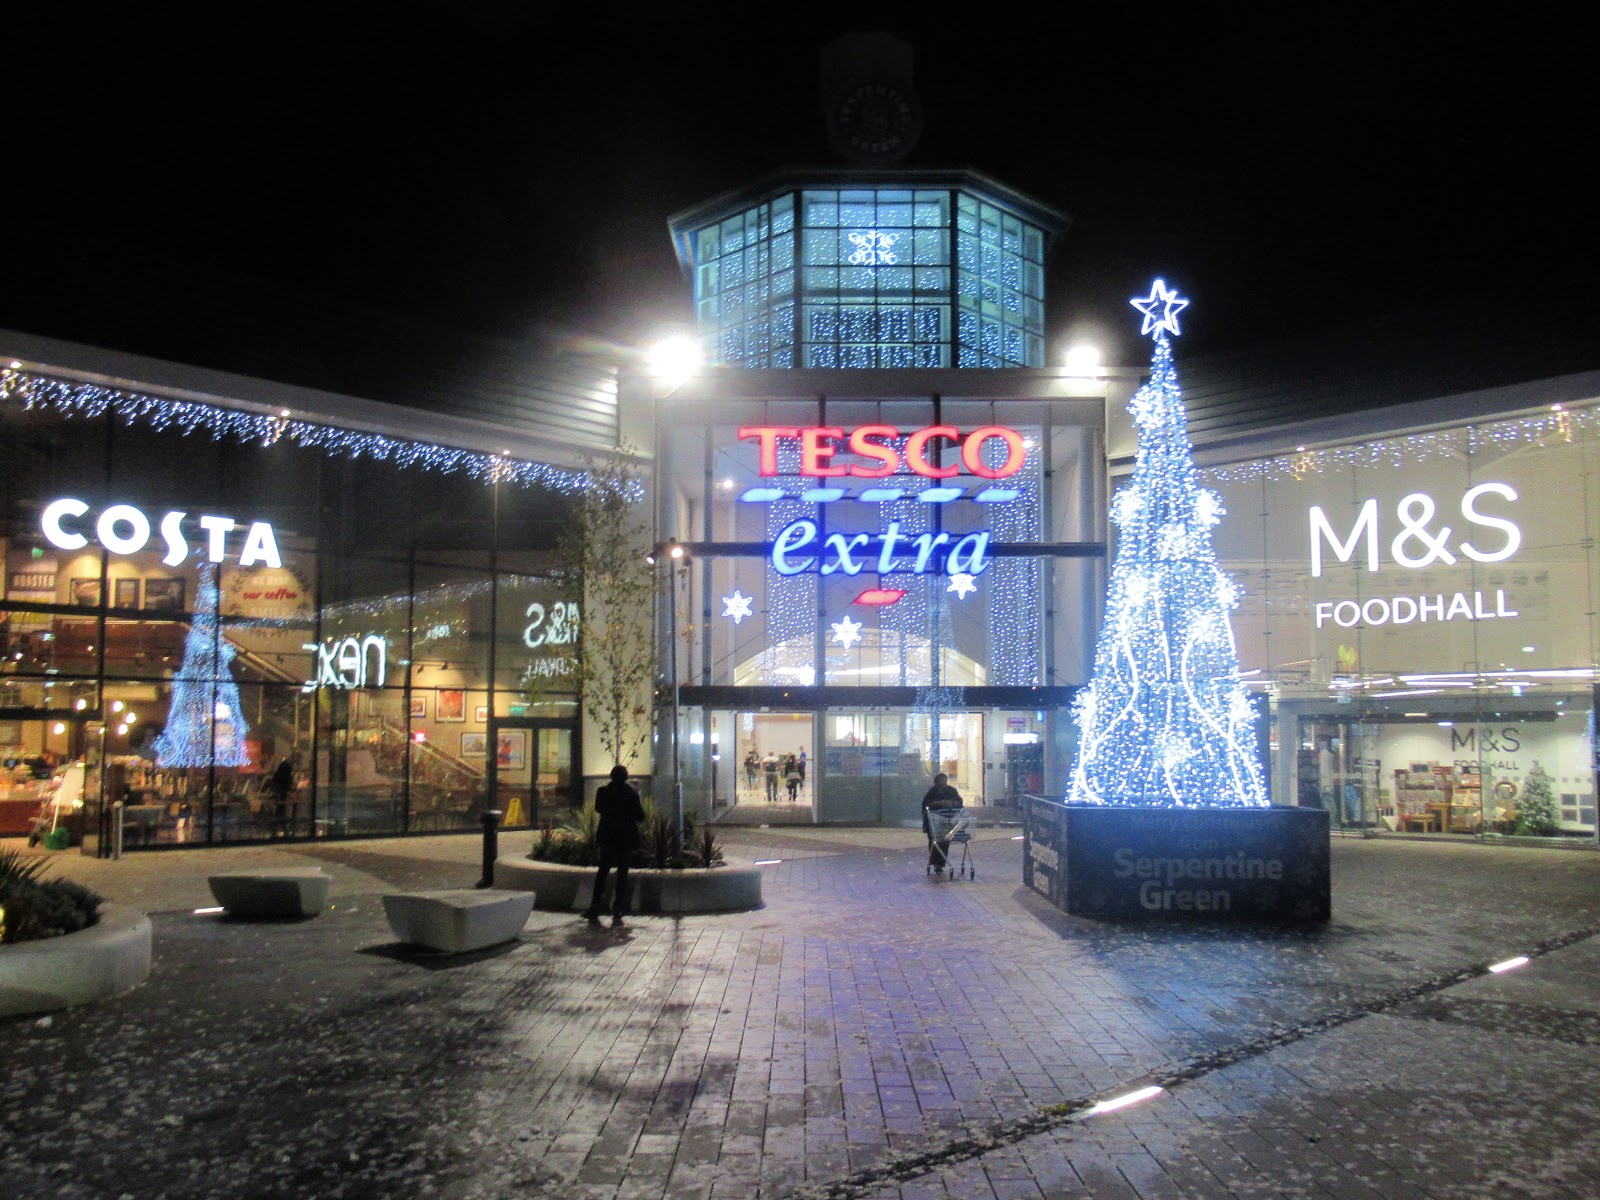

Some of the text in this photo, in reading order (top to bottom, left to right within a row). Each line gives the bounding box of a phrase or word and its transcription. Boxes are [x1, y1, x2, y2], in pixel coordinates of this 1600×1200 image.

[738, 425, 1027, 479] TESCO
[41, 498, 282, 569] COSTA
[771, 517, 990, 577] extra
[1309, 482, 1521, 577] M&S
[264, 588, 297, 601] coffee
[1316, 590, 1518, 628] FOODHALL
[1451, 727, 1520, 752] M&S
[1114, 848, 1283, 887] Serpentine
[1139, 880, 1231, 911] Green
